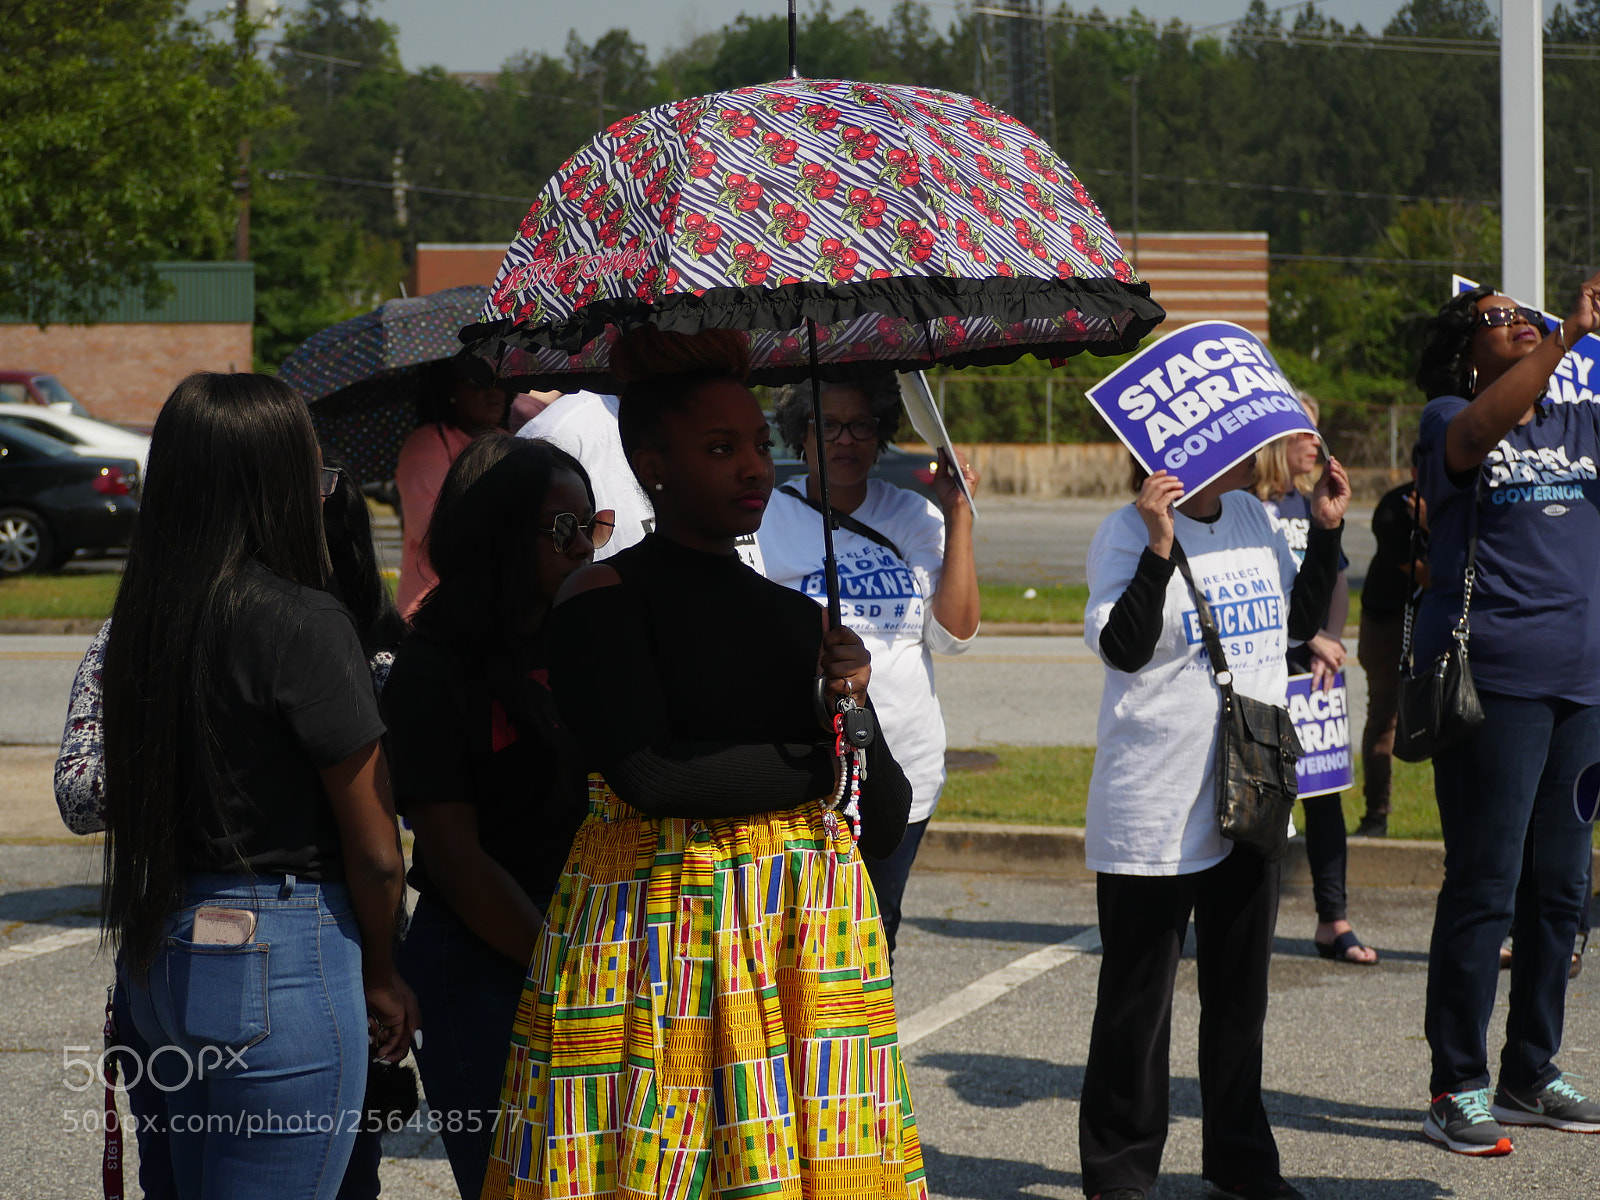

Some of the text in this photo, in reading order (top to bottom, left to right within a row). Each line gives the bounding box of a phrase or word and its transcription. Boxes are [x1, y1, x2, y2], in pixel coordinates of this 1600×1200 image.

[1118, 337, 1271, 421] STACEY
[1145, 365, 1299, 453] ABRAM
[1164, 395, 1306, 469] GOVERNOR
[1491, 485, 1585, 505] GOVERNOR
[806, 569, 921, 596] BCKNER
[1203, 567, 1260, 585] RE-ELECT
[839, 604, 882, 617] CSD
[894, 603, 905, 617] #
[107, 1139, 118, 1170] 1913
